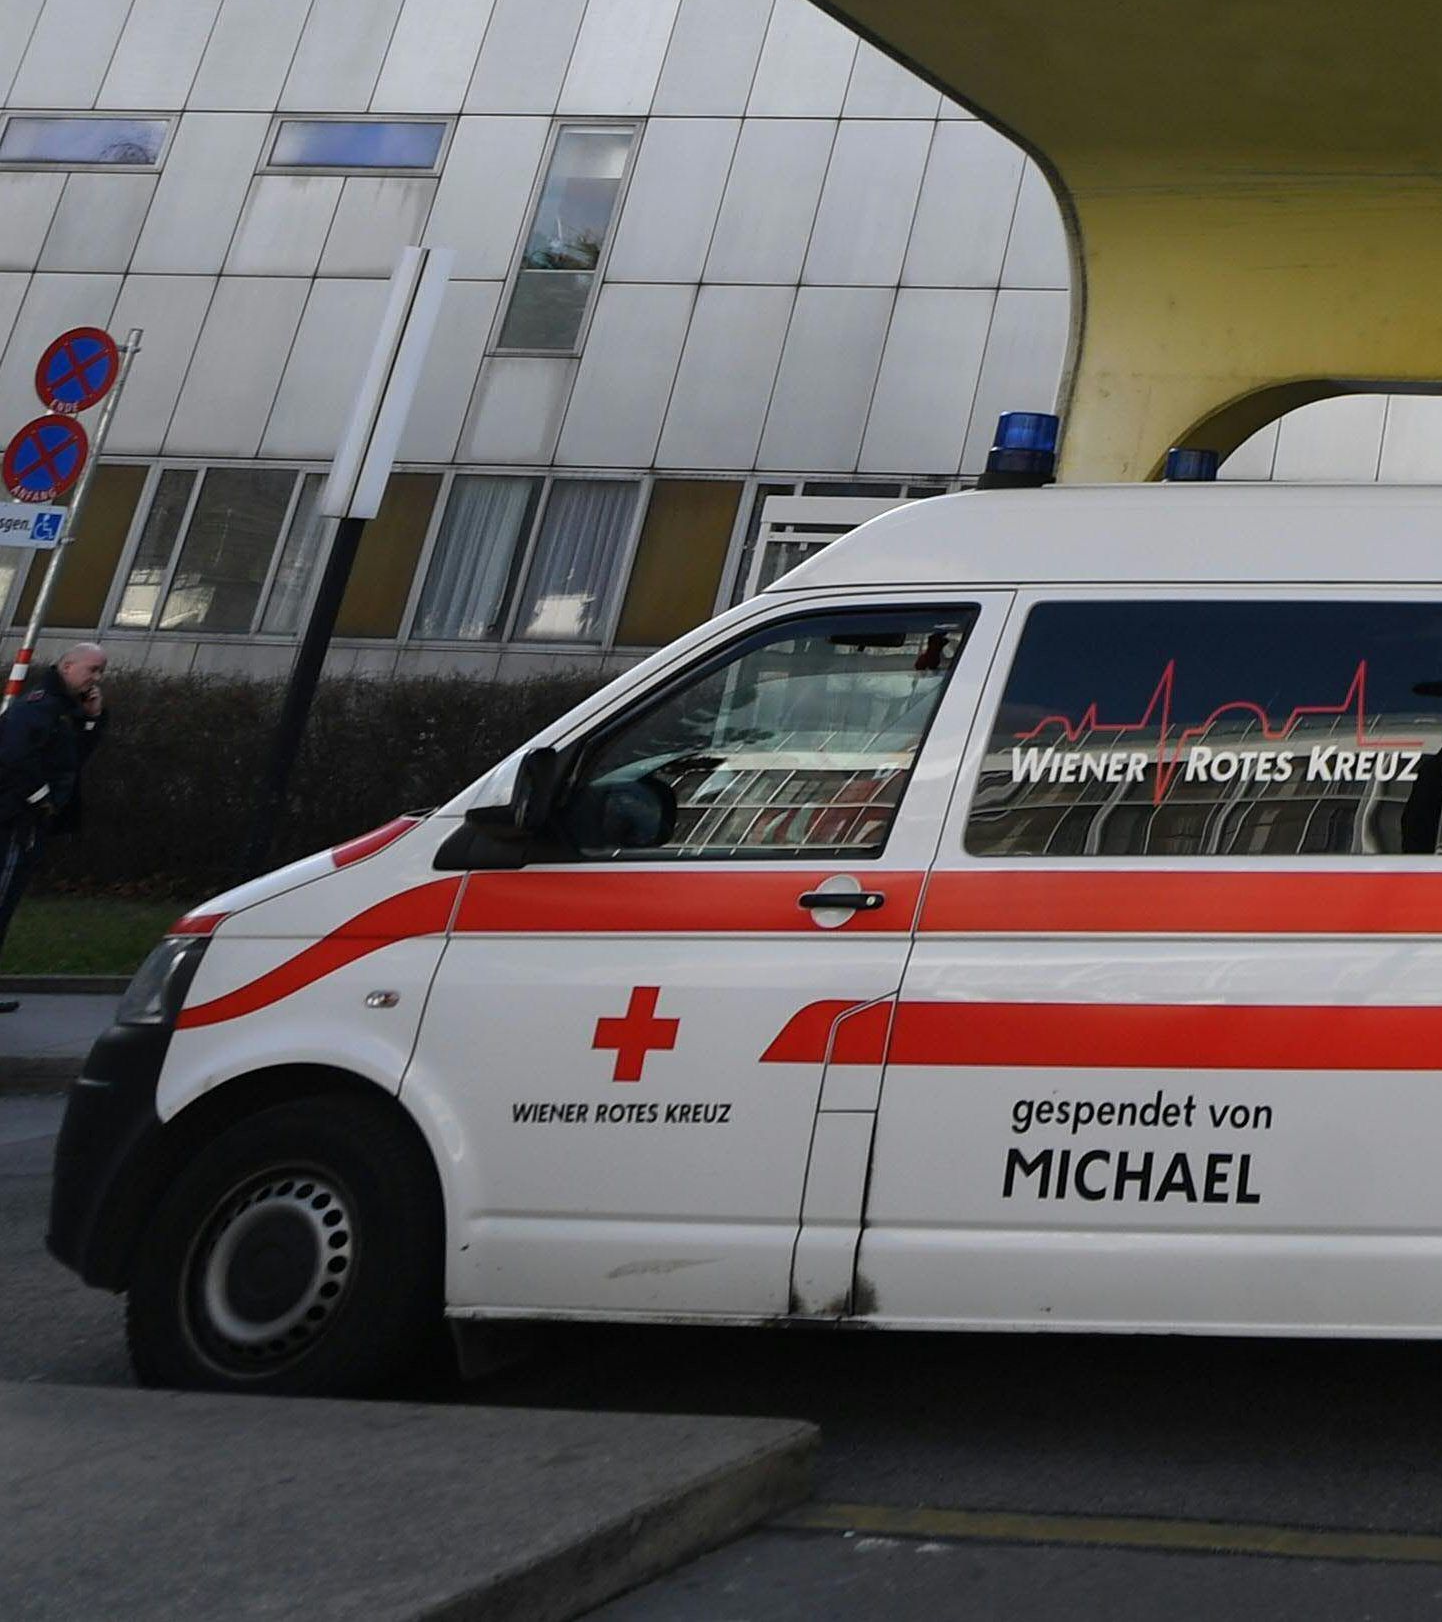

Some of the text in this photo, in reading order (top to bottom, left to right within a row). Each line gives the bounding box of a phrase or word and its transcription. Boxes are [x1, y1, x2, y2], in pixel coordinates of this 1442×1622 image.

[50, 398, 79, 413] ENDE
[10, 485, 58, 502] ANFANG
[1010, 744, 1424, 783] WIENER ROTES KREUZ
[512, 1103, 732, 1123] WIENER ROTES KREUZ
[1012, 1090, 1274, 1134] gespendet von
[1002, 1148, 1261, 1204] MICHAEL
